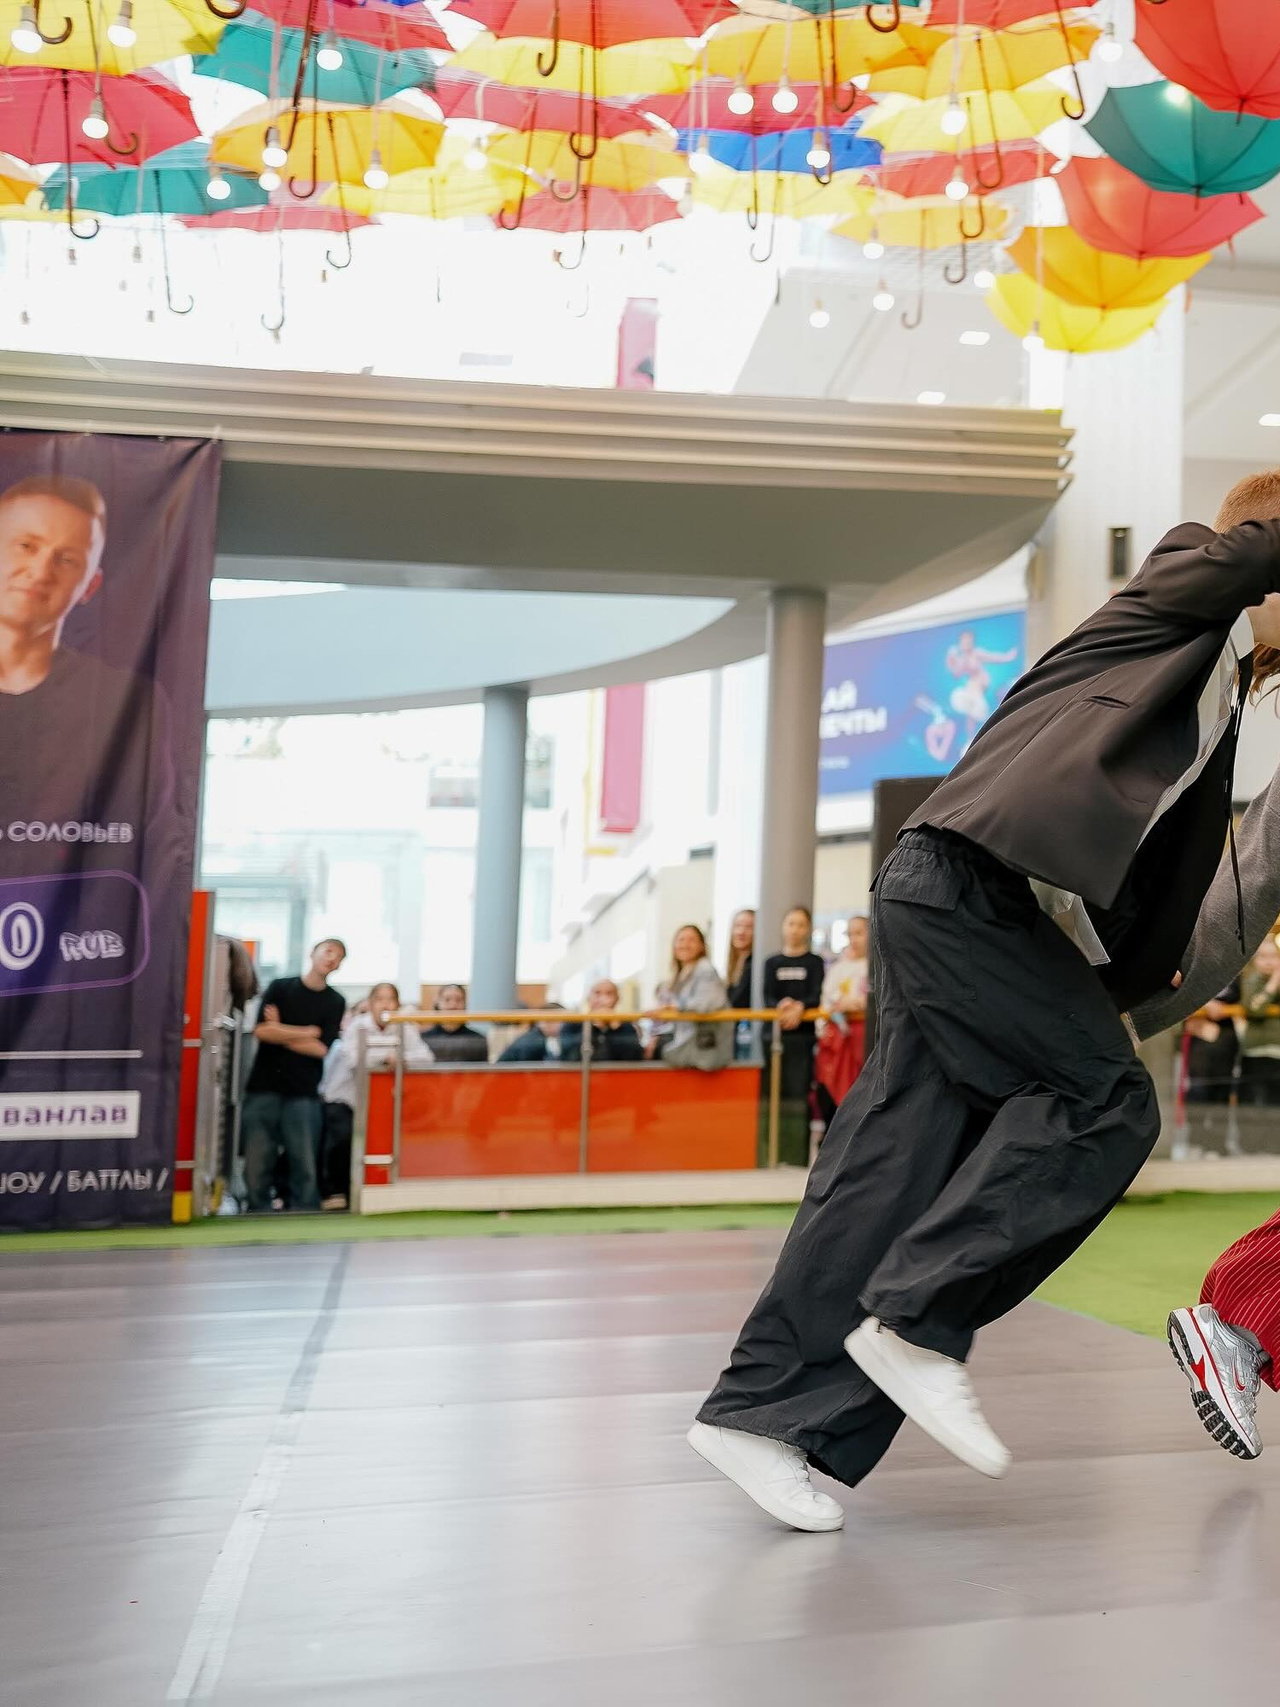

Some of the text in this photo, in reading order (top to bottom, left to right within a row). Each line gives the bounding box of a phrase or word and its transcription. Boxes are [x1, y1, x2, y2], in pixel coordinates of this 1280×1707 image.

[7, 820, 134, 844] СОЛОВЬЕВ
[59, 929, 126, 962] RUB
[67, 1168, 153, 1193] БАТТЛЫ
